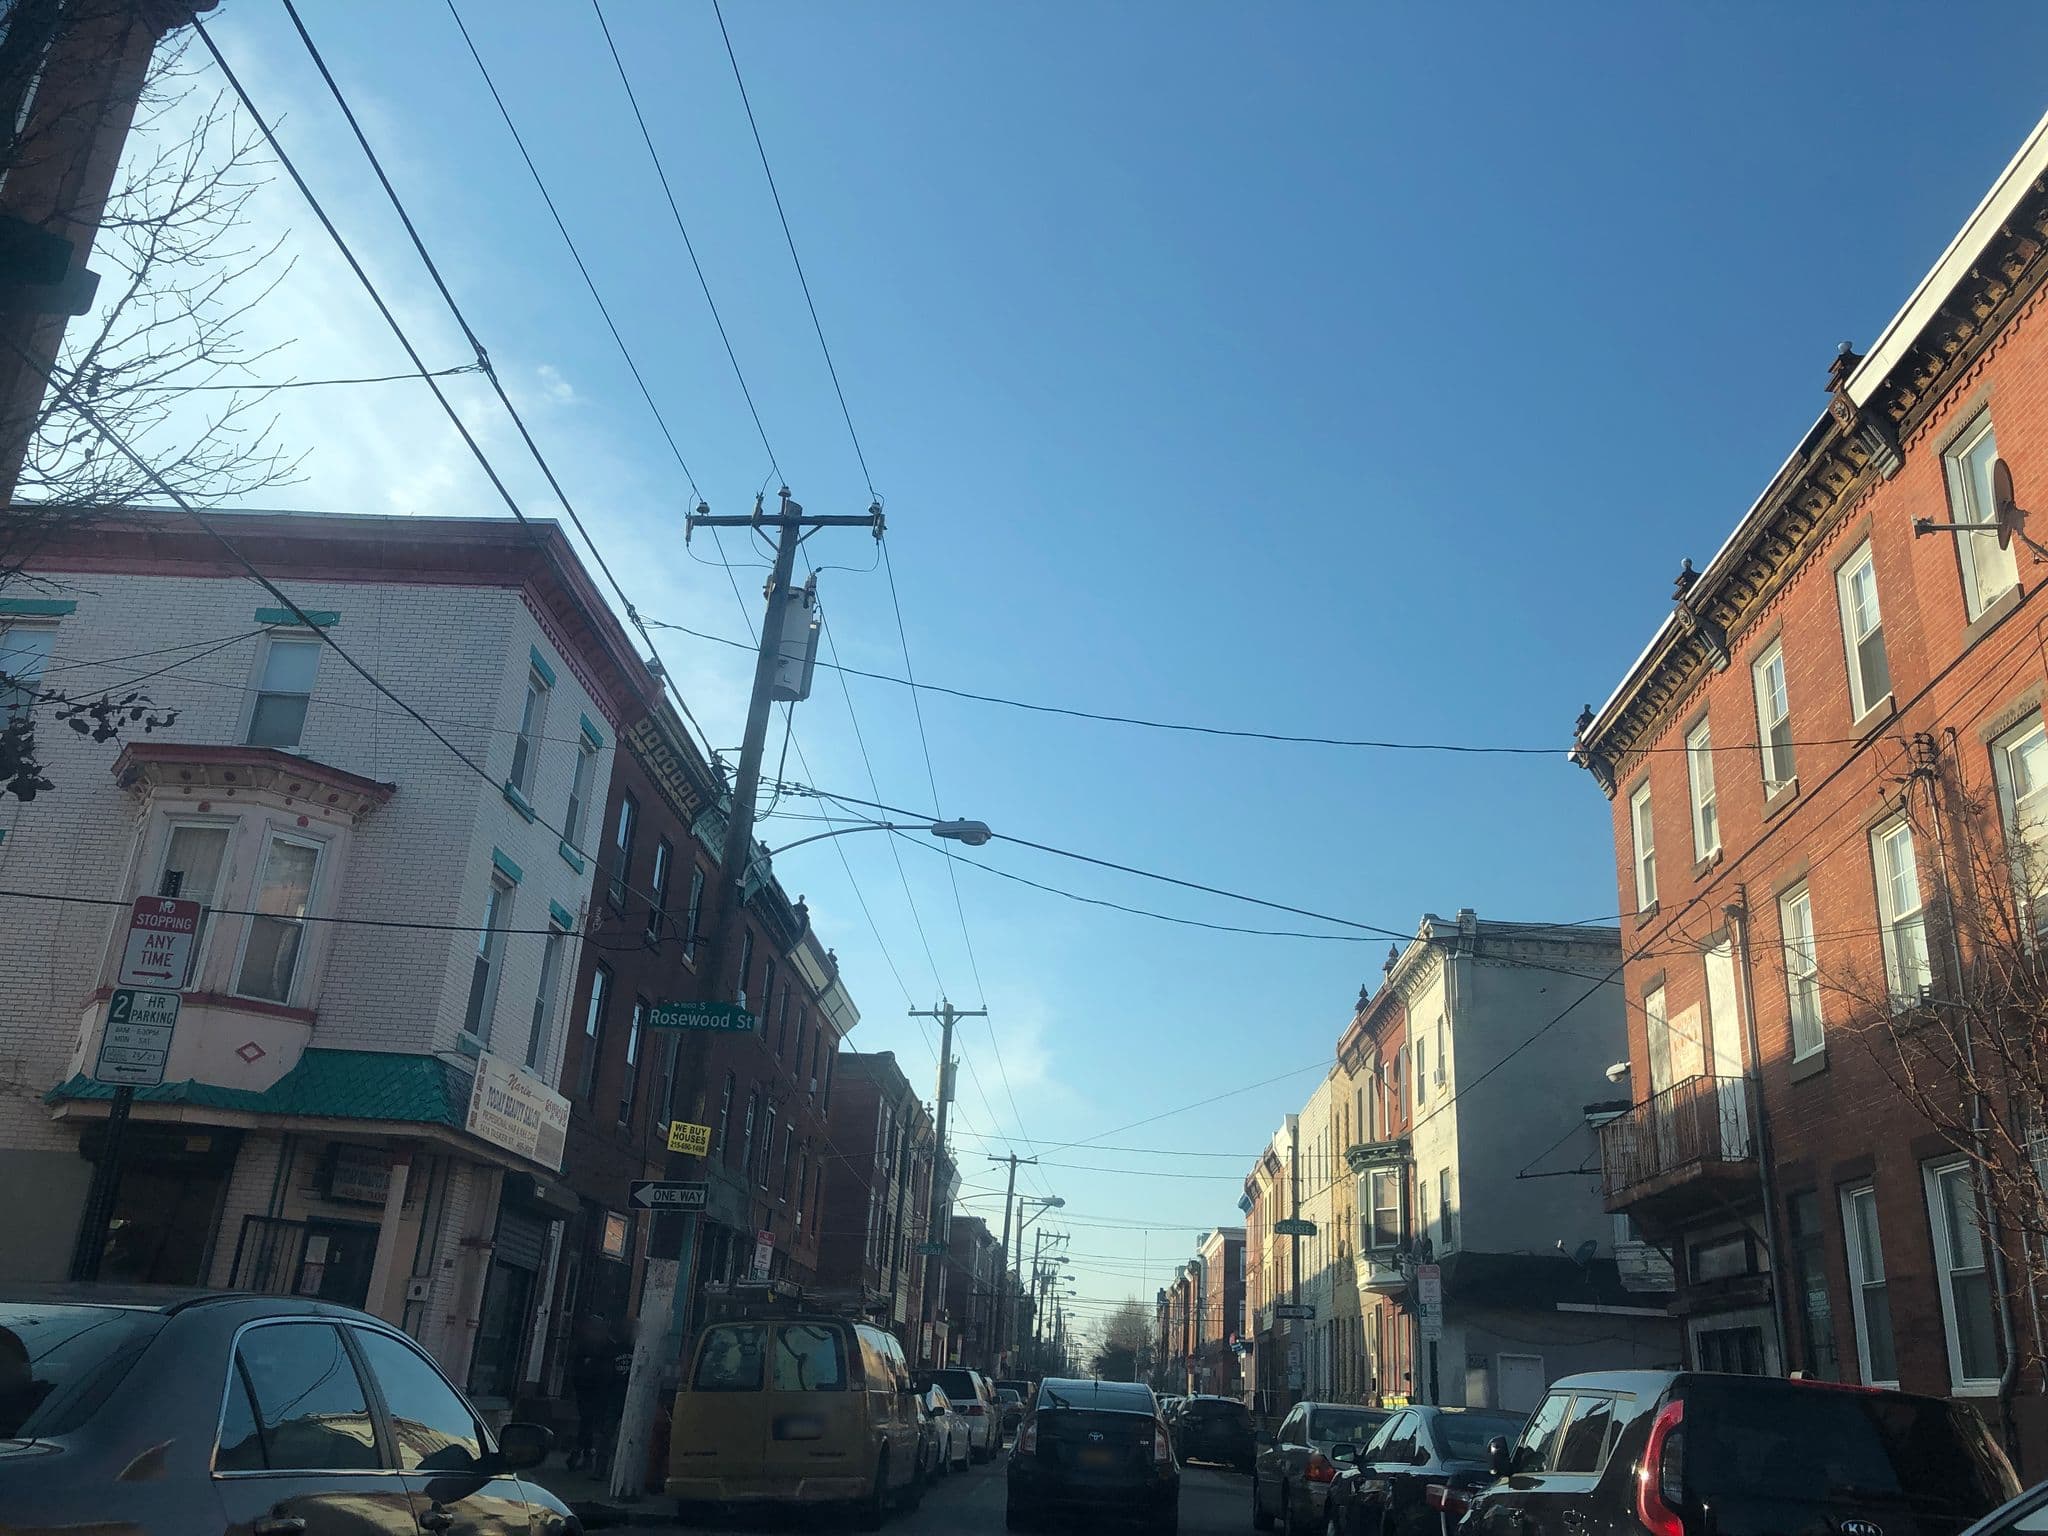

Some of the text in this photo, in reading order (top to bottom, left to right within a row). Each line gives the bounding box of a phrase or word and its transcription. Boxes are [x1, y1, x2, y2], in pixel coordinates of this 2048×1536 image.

[159, 901, 176, 914] NO
[136, 913, 192, 930] STOPPING
[145, 934, 176, 950] ANY
[141, 950, 175, 968] TIME
[113, 995, 129, 1019] 2
[148, 996, 166, 1009] HR
[131, 1009, 174, 1025] PARKING
[649, 1009, 753, 1030] Rosewood St
[503, 1093, 526, 1122] BEAUTY
[523, 1105, 541, 1130] SALON
[672, 1131, 706, 1146] HOUSES
[675, 1124, 707, 1137] WE BUY
[653, 1190, 704, 1202] ONE WAY
